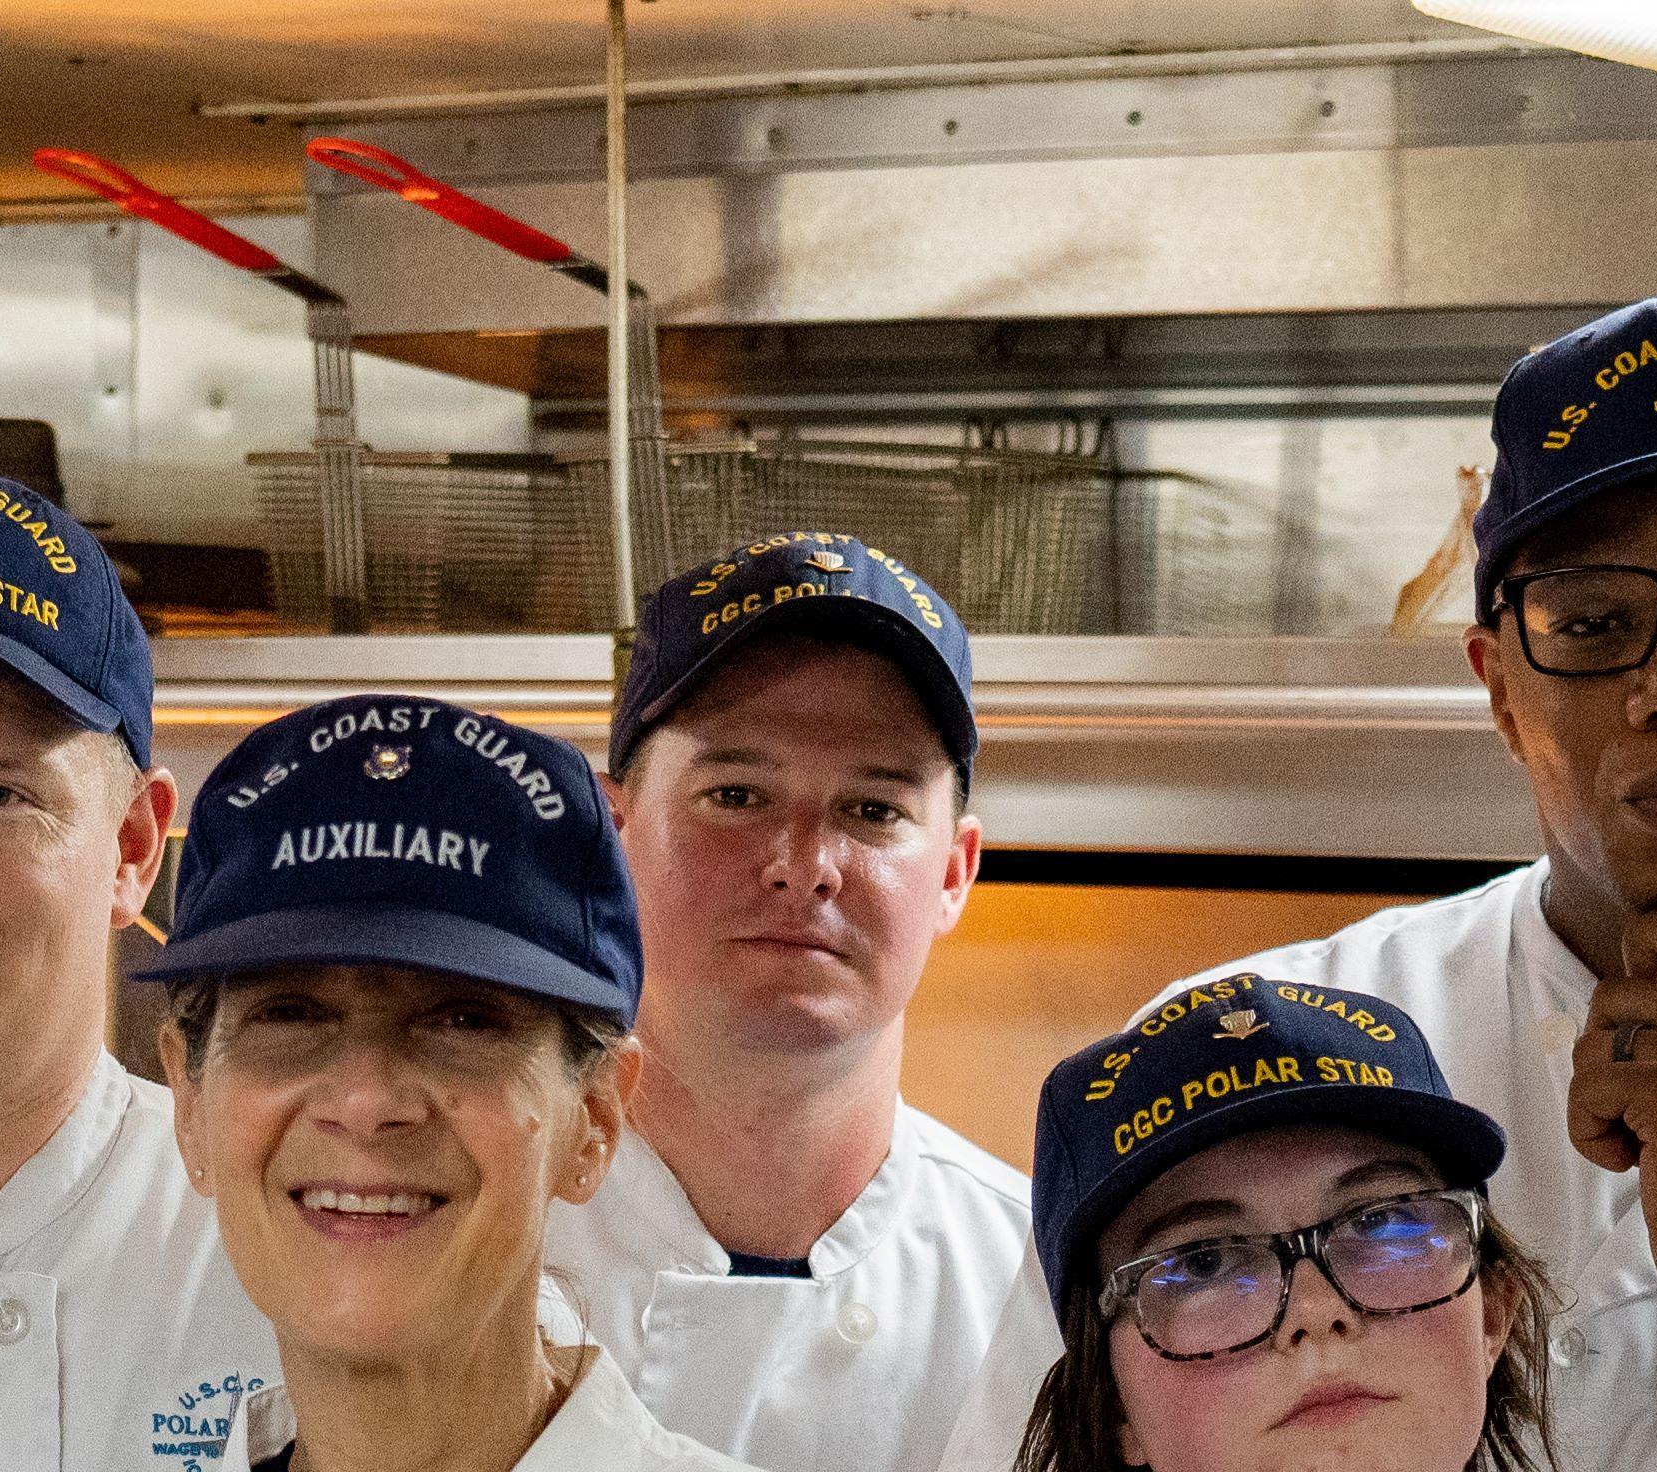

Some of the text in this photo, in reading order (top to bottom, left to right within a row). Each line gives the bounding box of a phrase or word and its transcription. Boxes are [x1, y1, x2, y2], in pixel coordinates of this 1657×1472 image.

[1542, 400, 1598, 451] U.S.
[702, 593, 762, 636] CGC
[227, 706, 566, 821] U.S. COAST GUARD
[271, 821, 490, 878] AUXILIARY
[1085, 974, 1397, 1103] U.S. COAST GUARD
[1113, 1056, 1394, 1156] CGC POLAR STAR
[152, 1413, 230, 1438] POLAR
